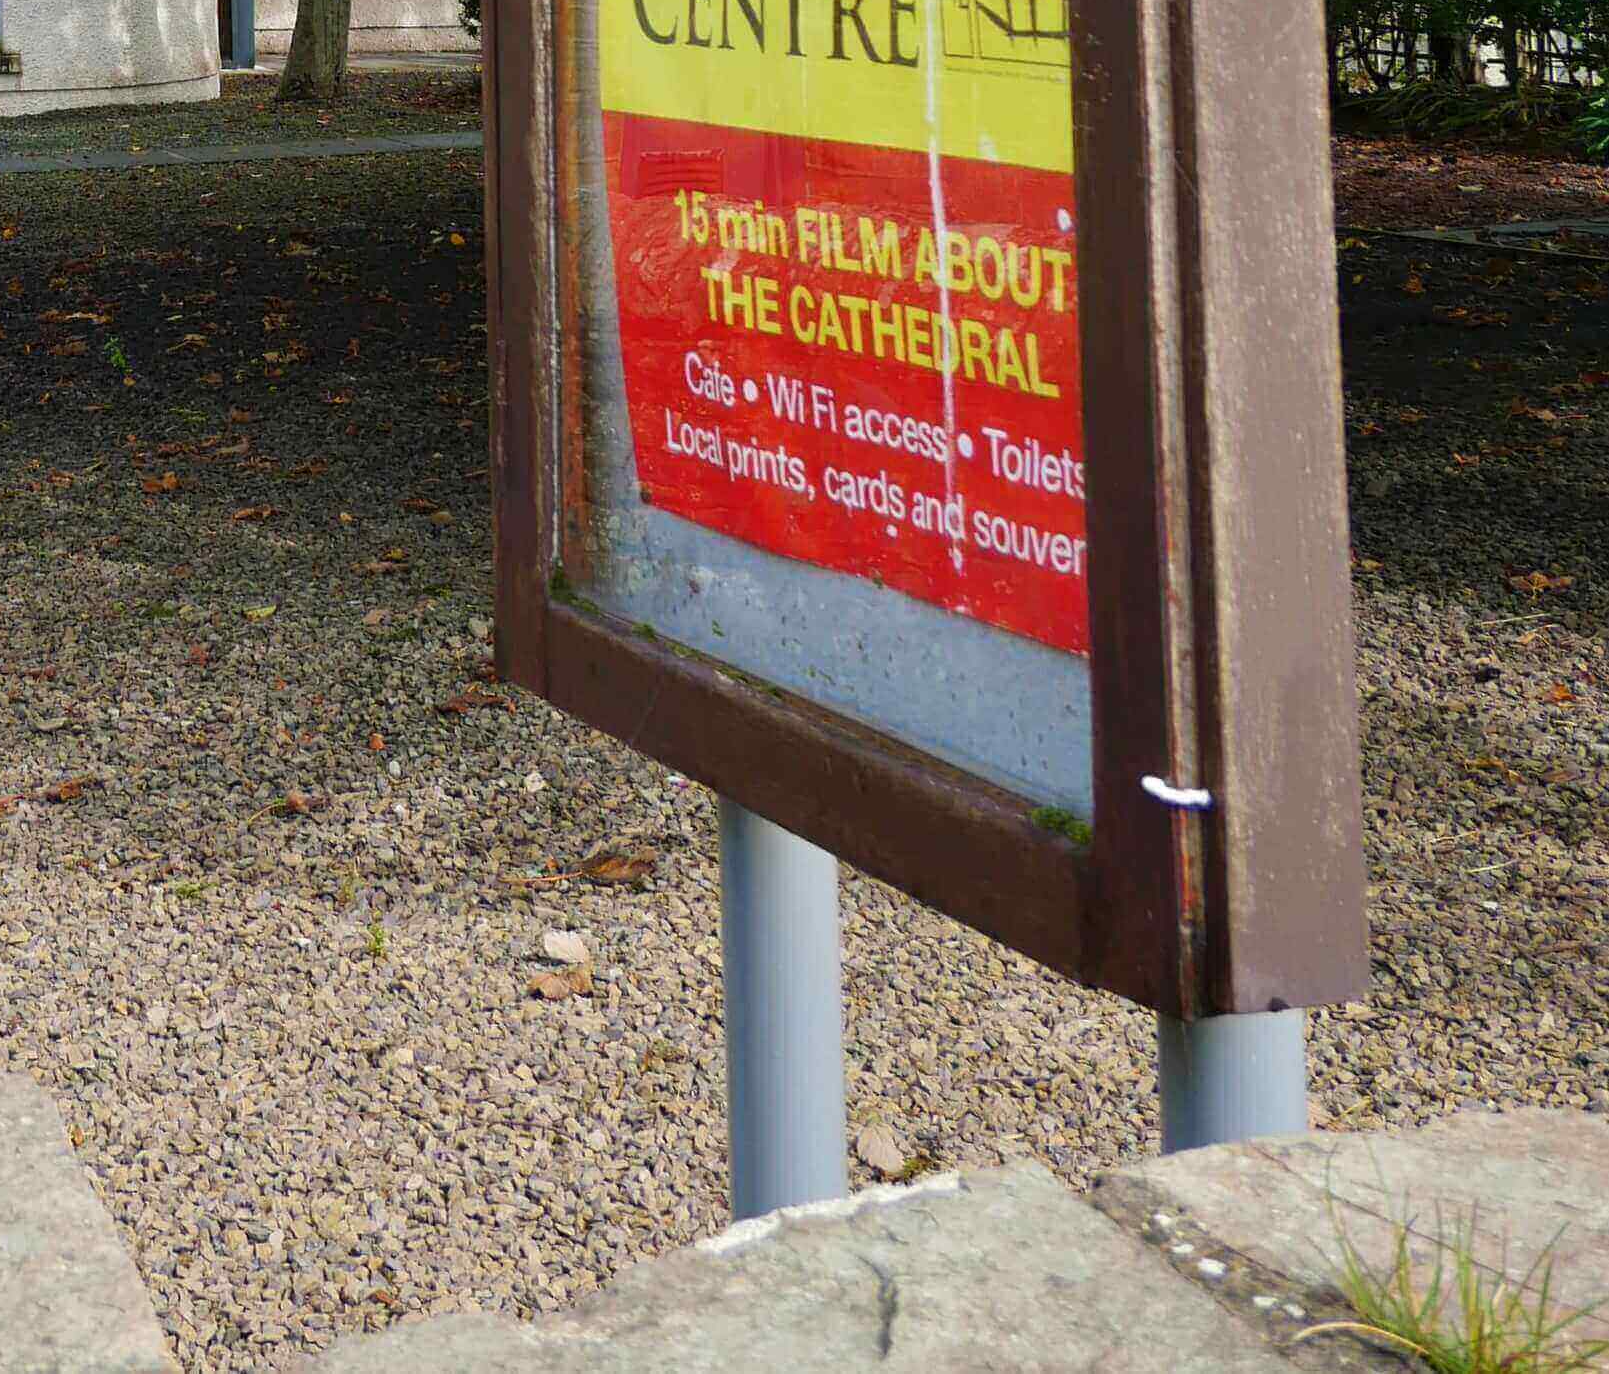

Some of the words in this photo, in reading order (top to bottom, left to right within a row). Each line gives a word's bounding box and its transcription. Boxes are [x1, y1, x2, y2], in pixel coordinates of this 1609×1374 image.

[674, 188, 709, 245] 15
[718, 199, 790, 259] min
[796, 207, 903, 279] FILM
[913, 227, 1072, 312] ABOUT
[700, 266, 783, 335] THE
[789, 285, 1061, 398] CATHEDRAL
[666, 408, 722, 467] Local
[727, 436, 817, 503] prints,
[823, 465, 905, 520] cards
[911, 488, 966, 541] and
[766, 374, 807, 425] Wi
[812, 384, 838, 433] Fi
[844, 406, 949, 463] access
